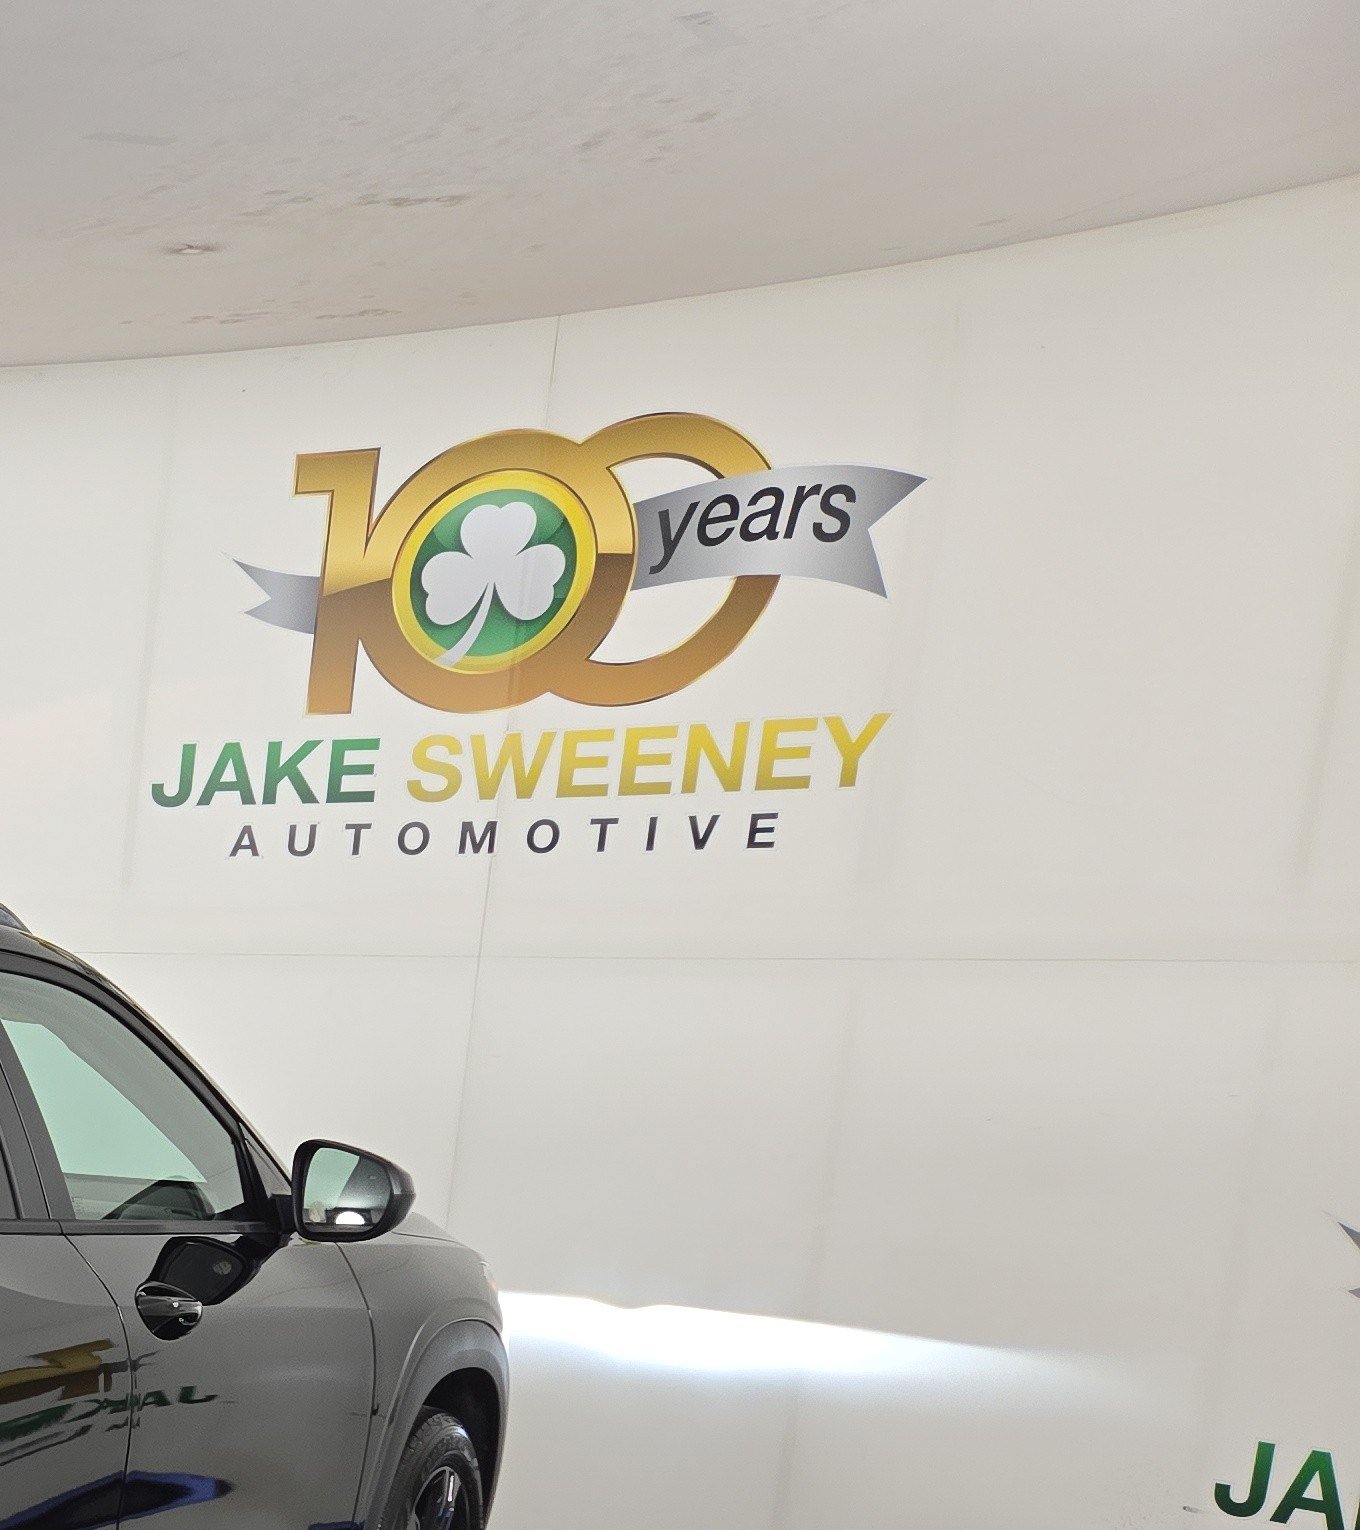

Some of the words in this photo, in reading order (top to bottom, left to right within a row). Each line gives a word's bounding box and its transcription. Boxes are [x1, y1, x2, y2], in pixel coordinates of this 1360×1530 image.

[649, 480, 857, 575] years
[151, 737, 381, 807] JAKE
[407, 712, 891, 803] SWEENEY
[229, 812, 781, 859] AUTOMOTIVE
